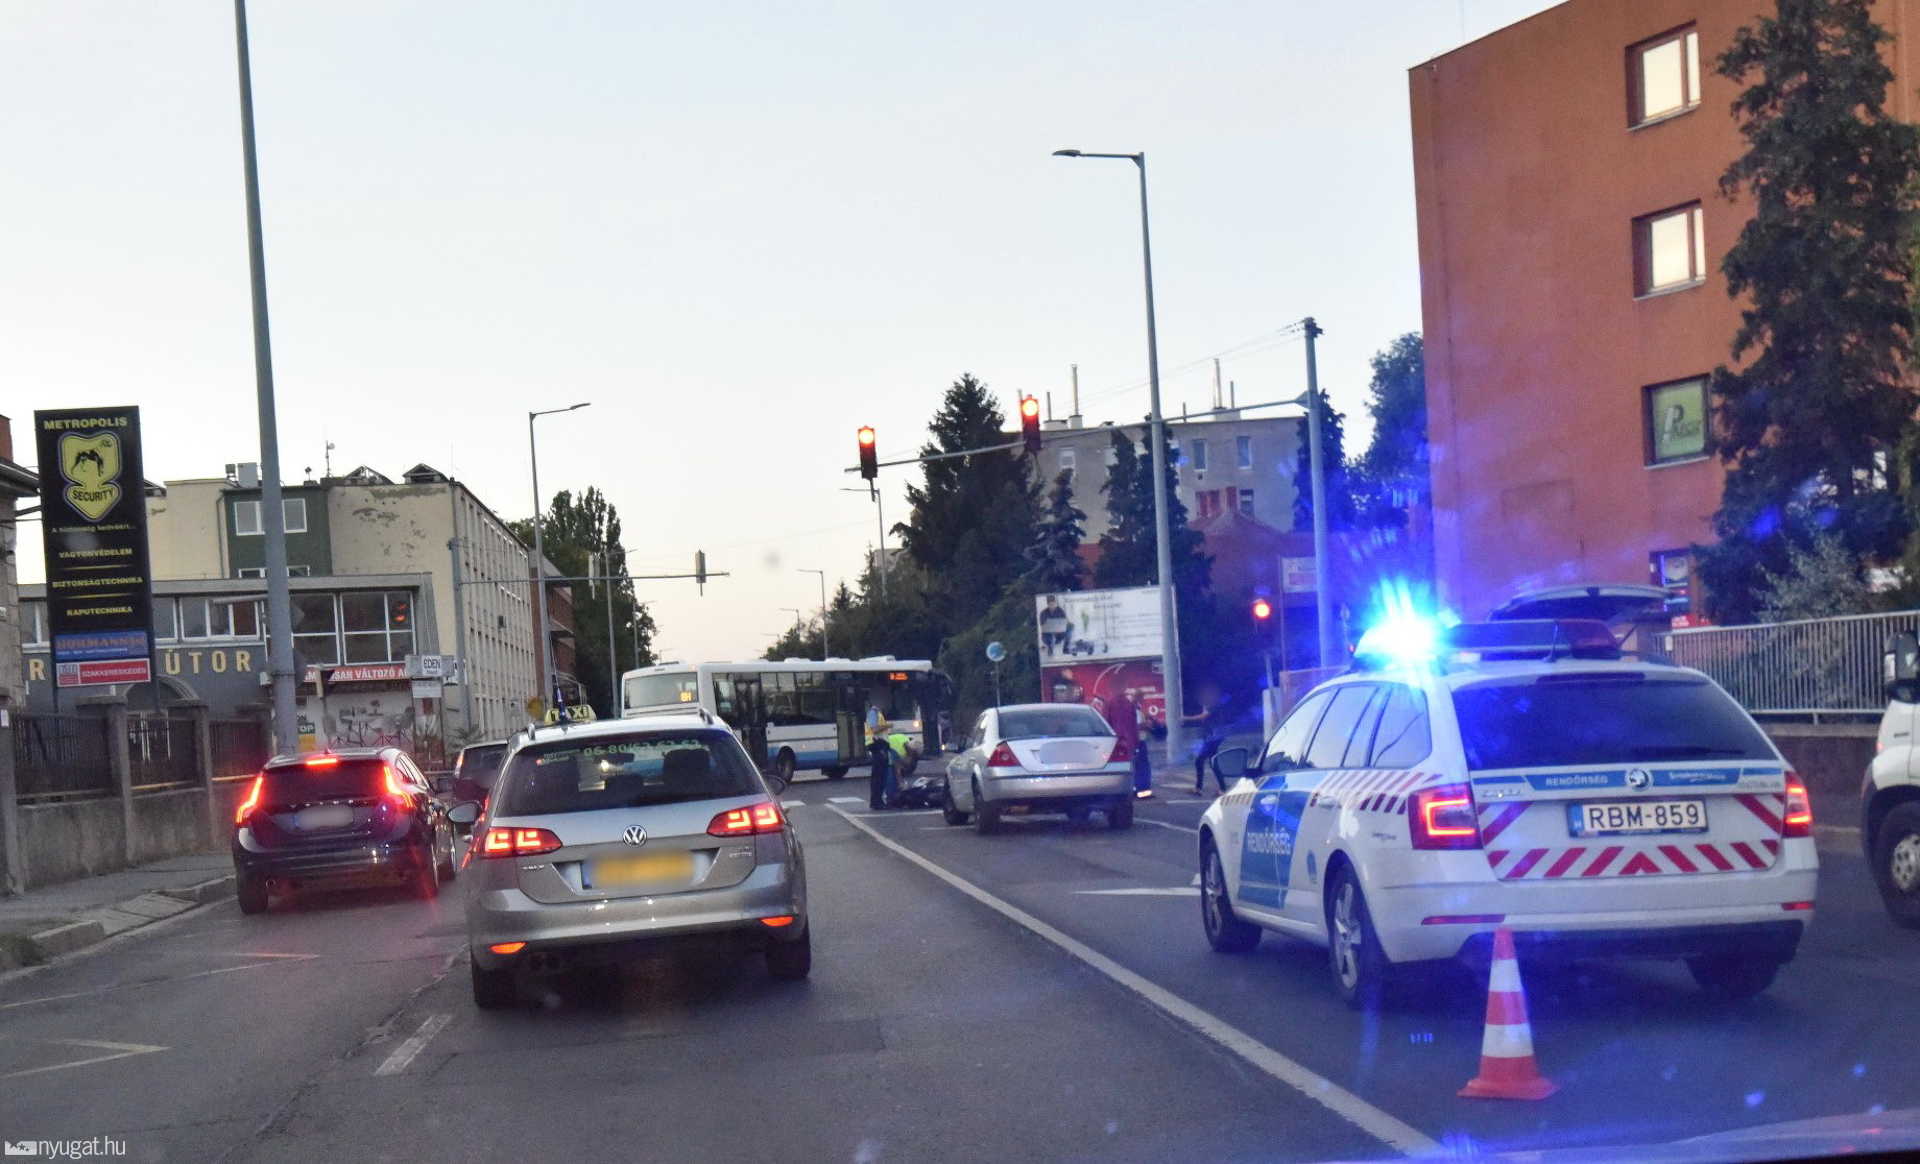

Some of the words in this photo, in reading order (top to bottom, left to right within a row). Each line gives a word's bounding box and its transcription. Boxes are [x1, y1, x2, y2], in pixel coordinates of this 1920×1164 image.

[43, 417, 128, 429] METROPOLIS
[72, 489, 114, 503] SECURITY
[164, 648, 252, 675] ÚTOR
[1589, 803, 1700, 829] RBM-859
